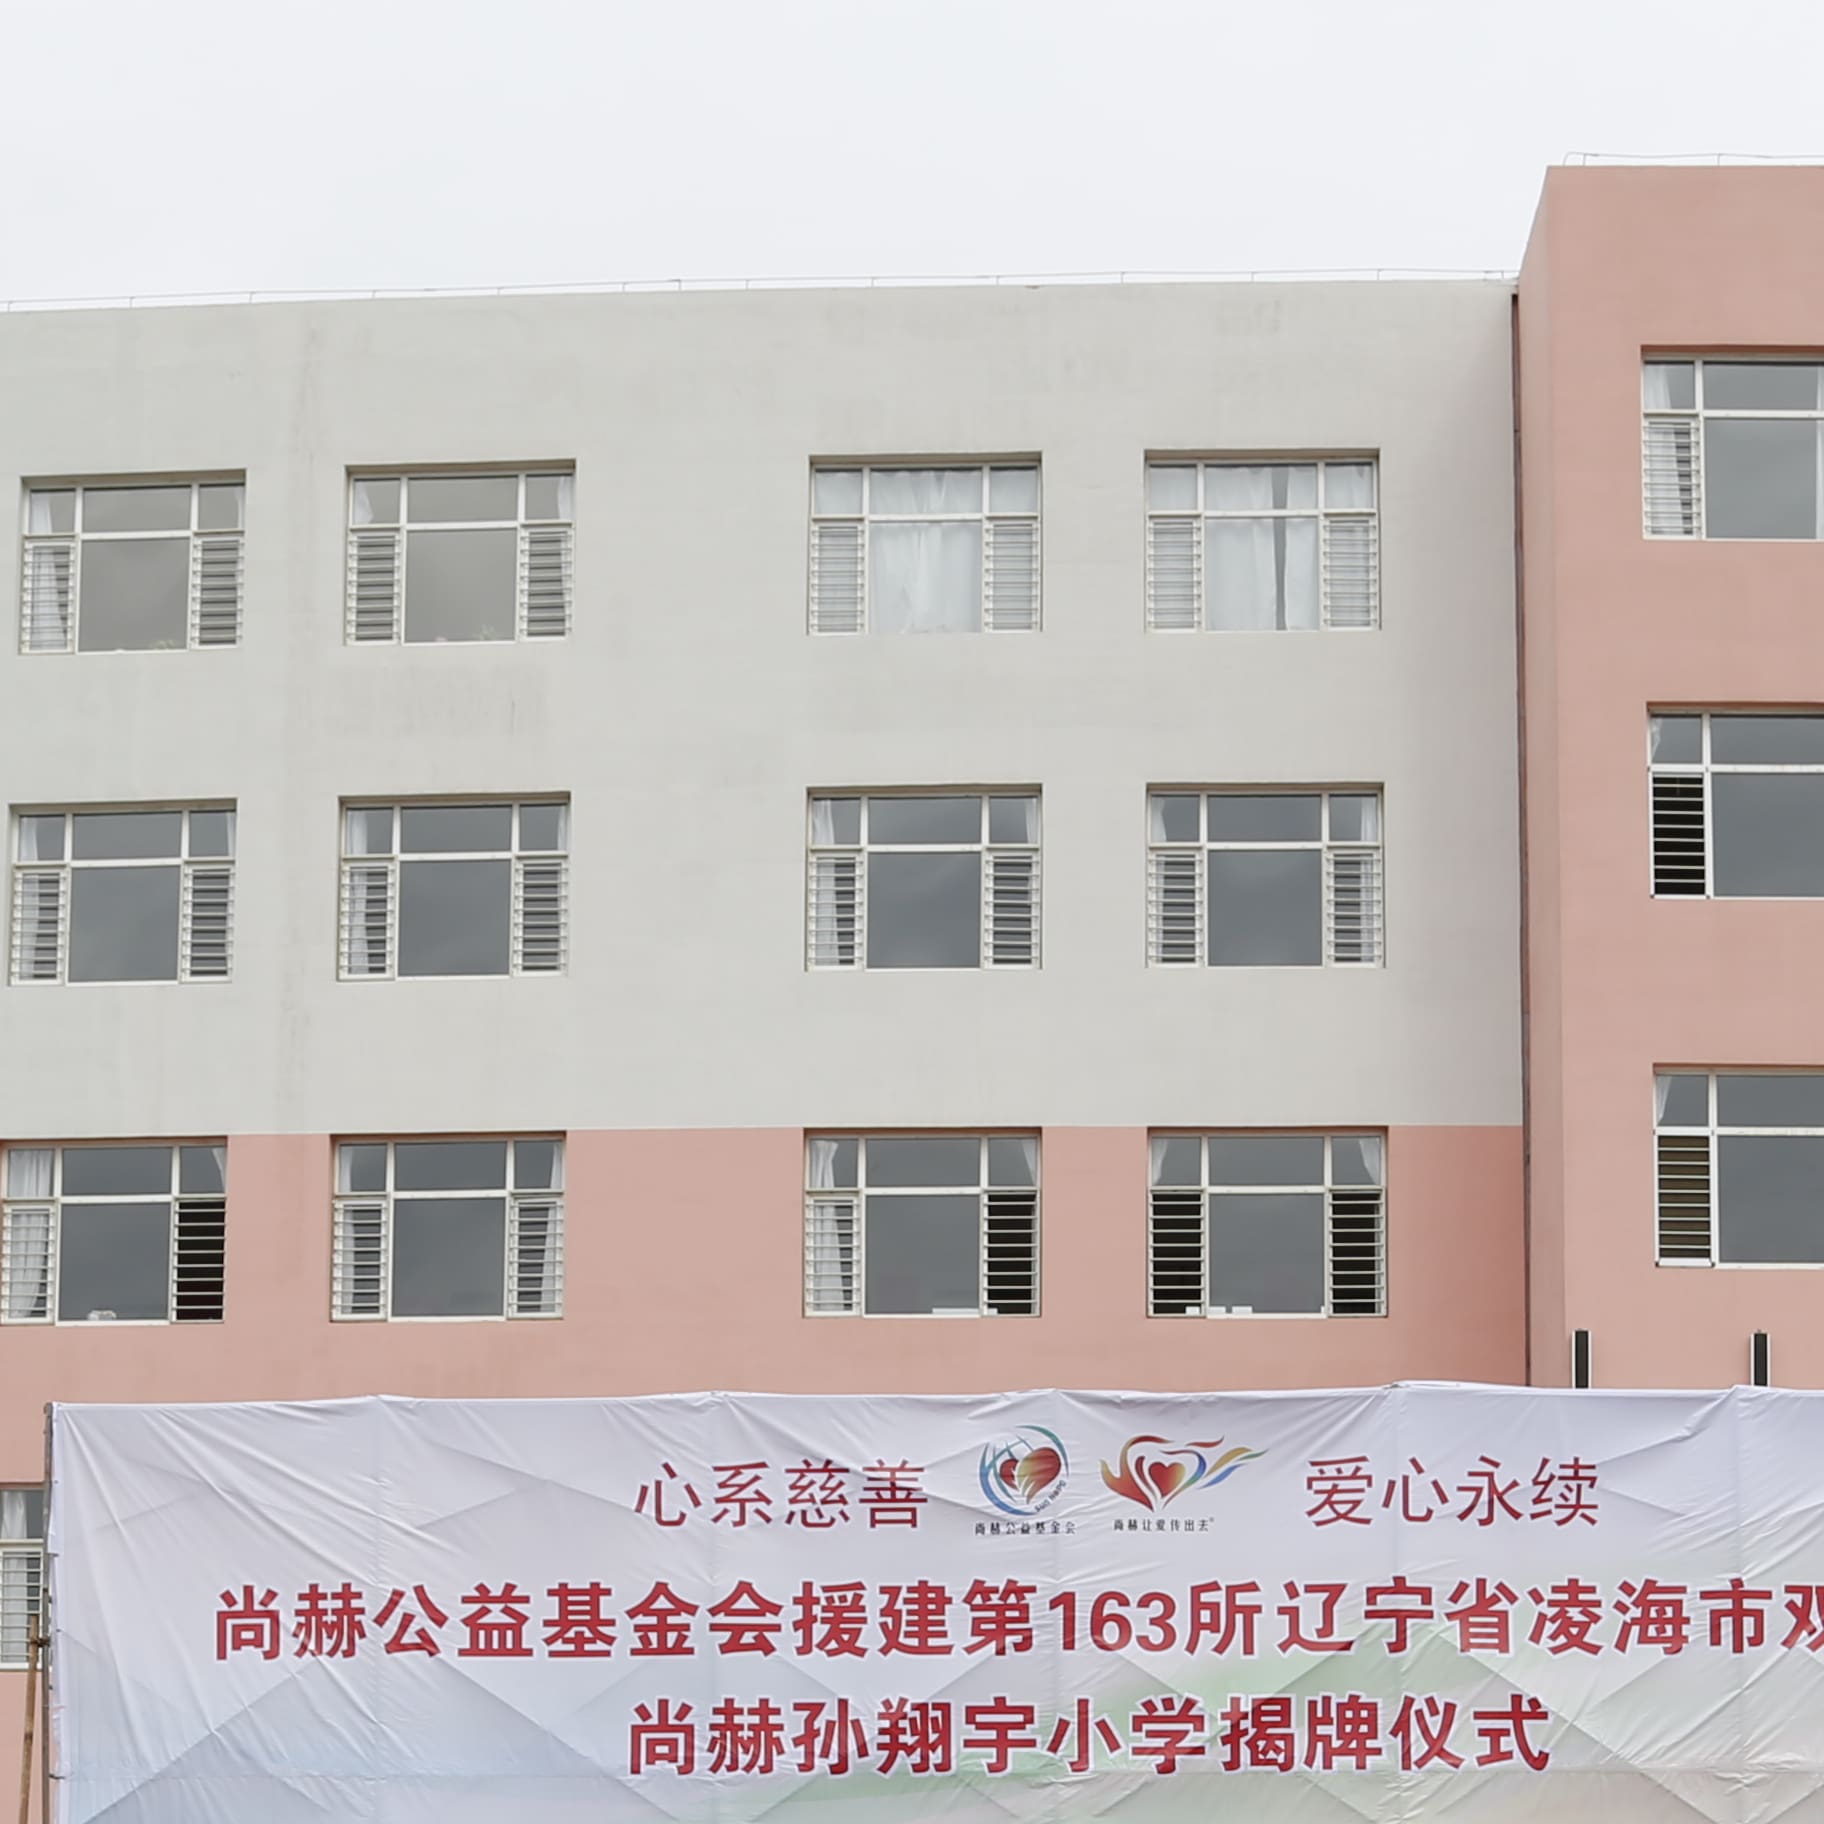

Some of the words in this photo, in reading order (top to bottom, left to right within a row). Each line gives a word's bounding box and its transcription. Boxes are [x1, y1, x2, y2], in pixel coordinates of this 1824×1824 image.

[637, 1461, 926, 1529] 心系慈善
[1307, 1456, 1598, 1527] 爱心永续
[974, 1520, 1076, 1536] 尚赫公益基金会
[630, 1694, 1551, 1776] 尚赫孙翔宇小学揭牌仪式
